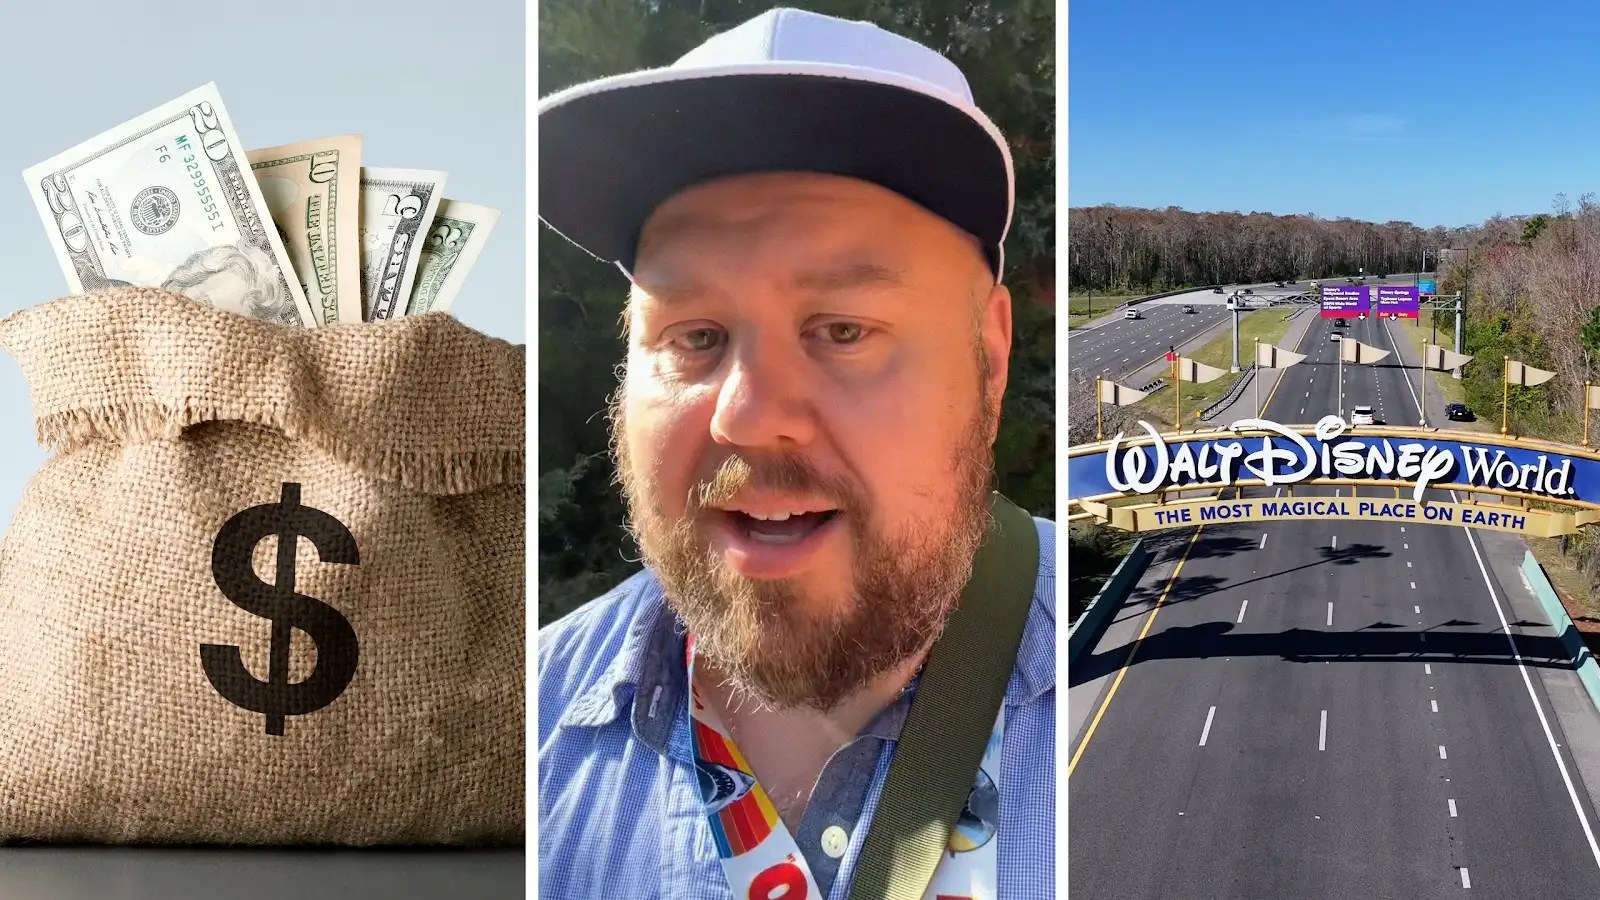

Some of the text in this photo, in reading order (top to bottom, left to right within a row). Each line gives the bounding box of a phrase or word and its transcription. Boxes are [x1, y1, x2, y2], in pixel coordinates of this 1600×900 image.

[174, 134, 191, 152] MF
[190, 101, 229, 161] 20
[154, 144, 171, 163] F6
[309, 150, 338, 183] 10
[182, 153, 220, 221] 32995555
[227, 171, 259, 234] FEDERAL
[41, 172, 88, 253] 20
[381, 194, 424, 219] 5
[432, 224, 462, 246] 2
[1155, 502, 1526, 530] THE MOST MAGICAL PLACE ON EARTH
[199, 482, 361, 737] $
